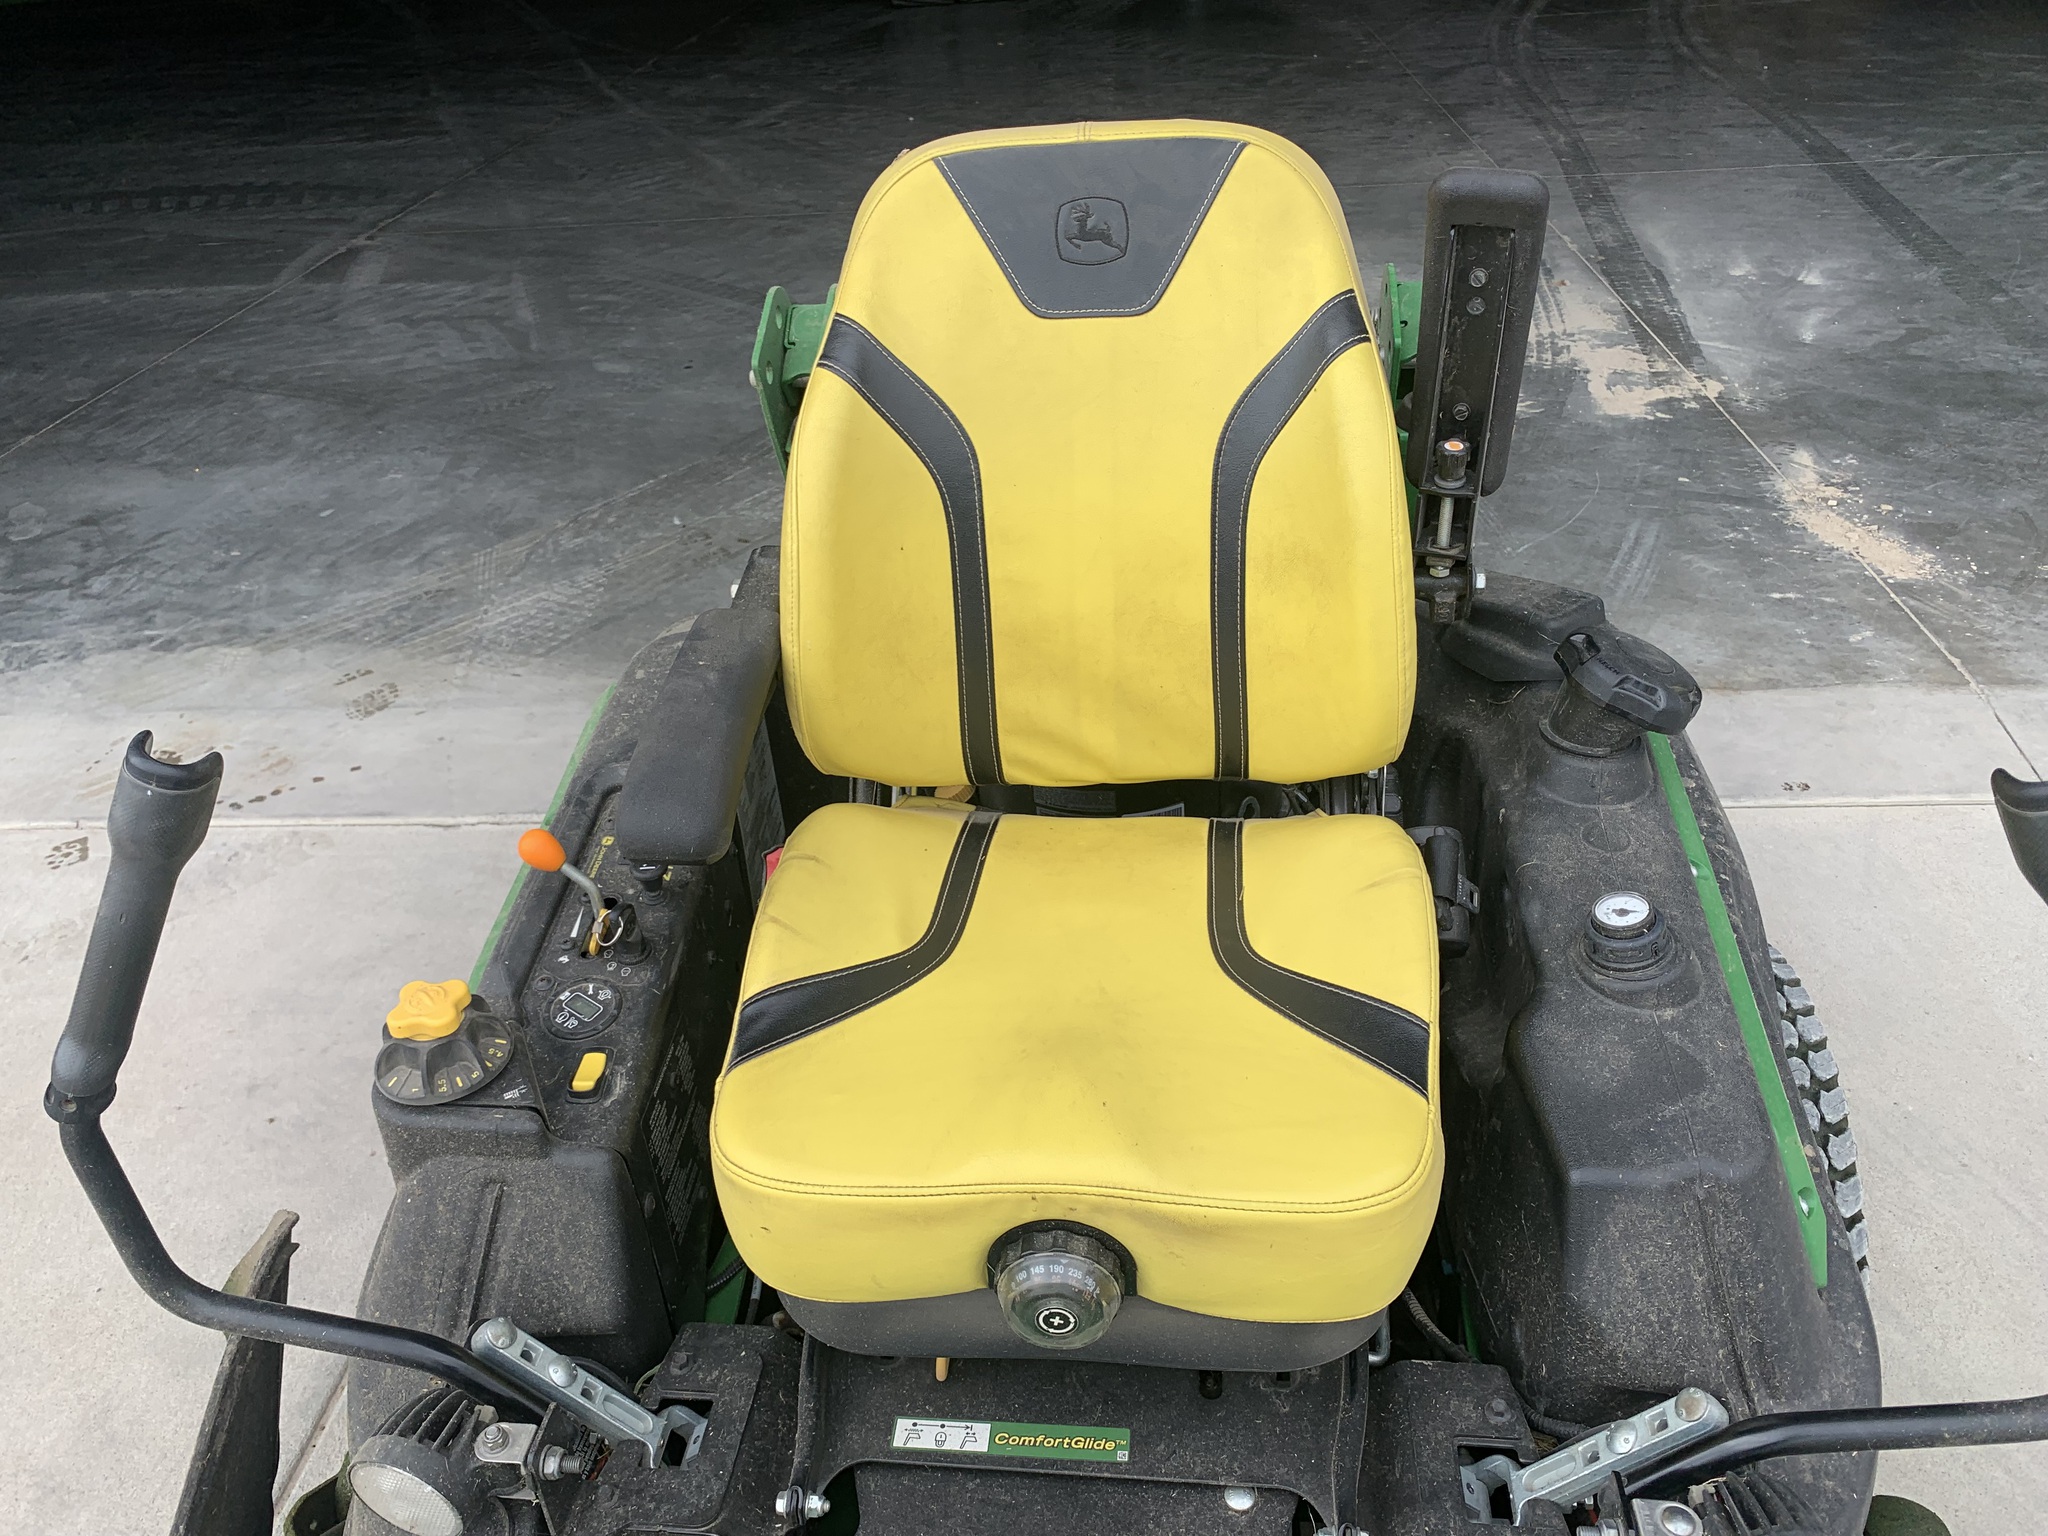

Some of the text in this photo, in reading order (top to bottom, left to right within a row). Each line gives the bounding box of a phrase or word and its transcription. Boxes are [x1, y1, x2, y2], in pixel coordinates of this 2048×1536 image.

[589, 861, 602, 878] DEERE
[488, 1047, 504, 1058] 4.5
[439, 1079, 447, 1092] 5.5
[1015, 1270, 1027, 1283] 100
[1030, 1264, 1045, 1275] 145
[1049, 1264, 1064, 1274] 190
[1067, 1267, 1083, 1279] 235
